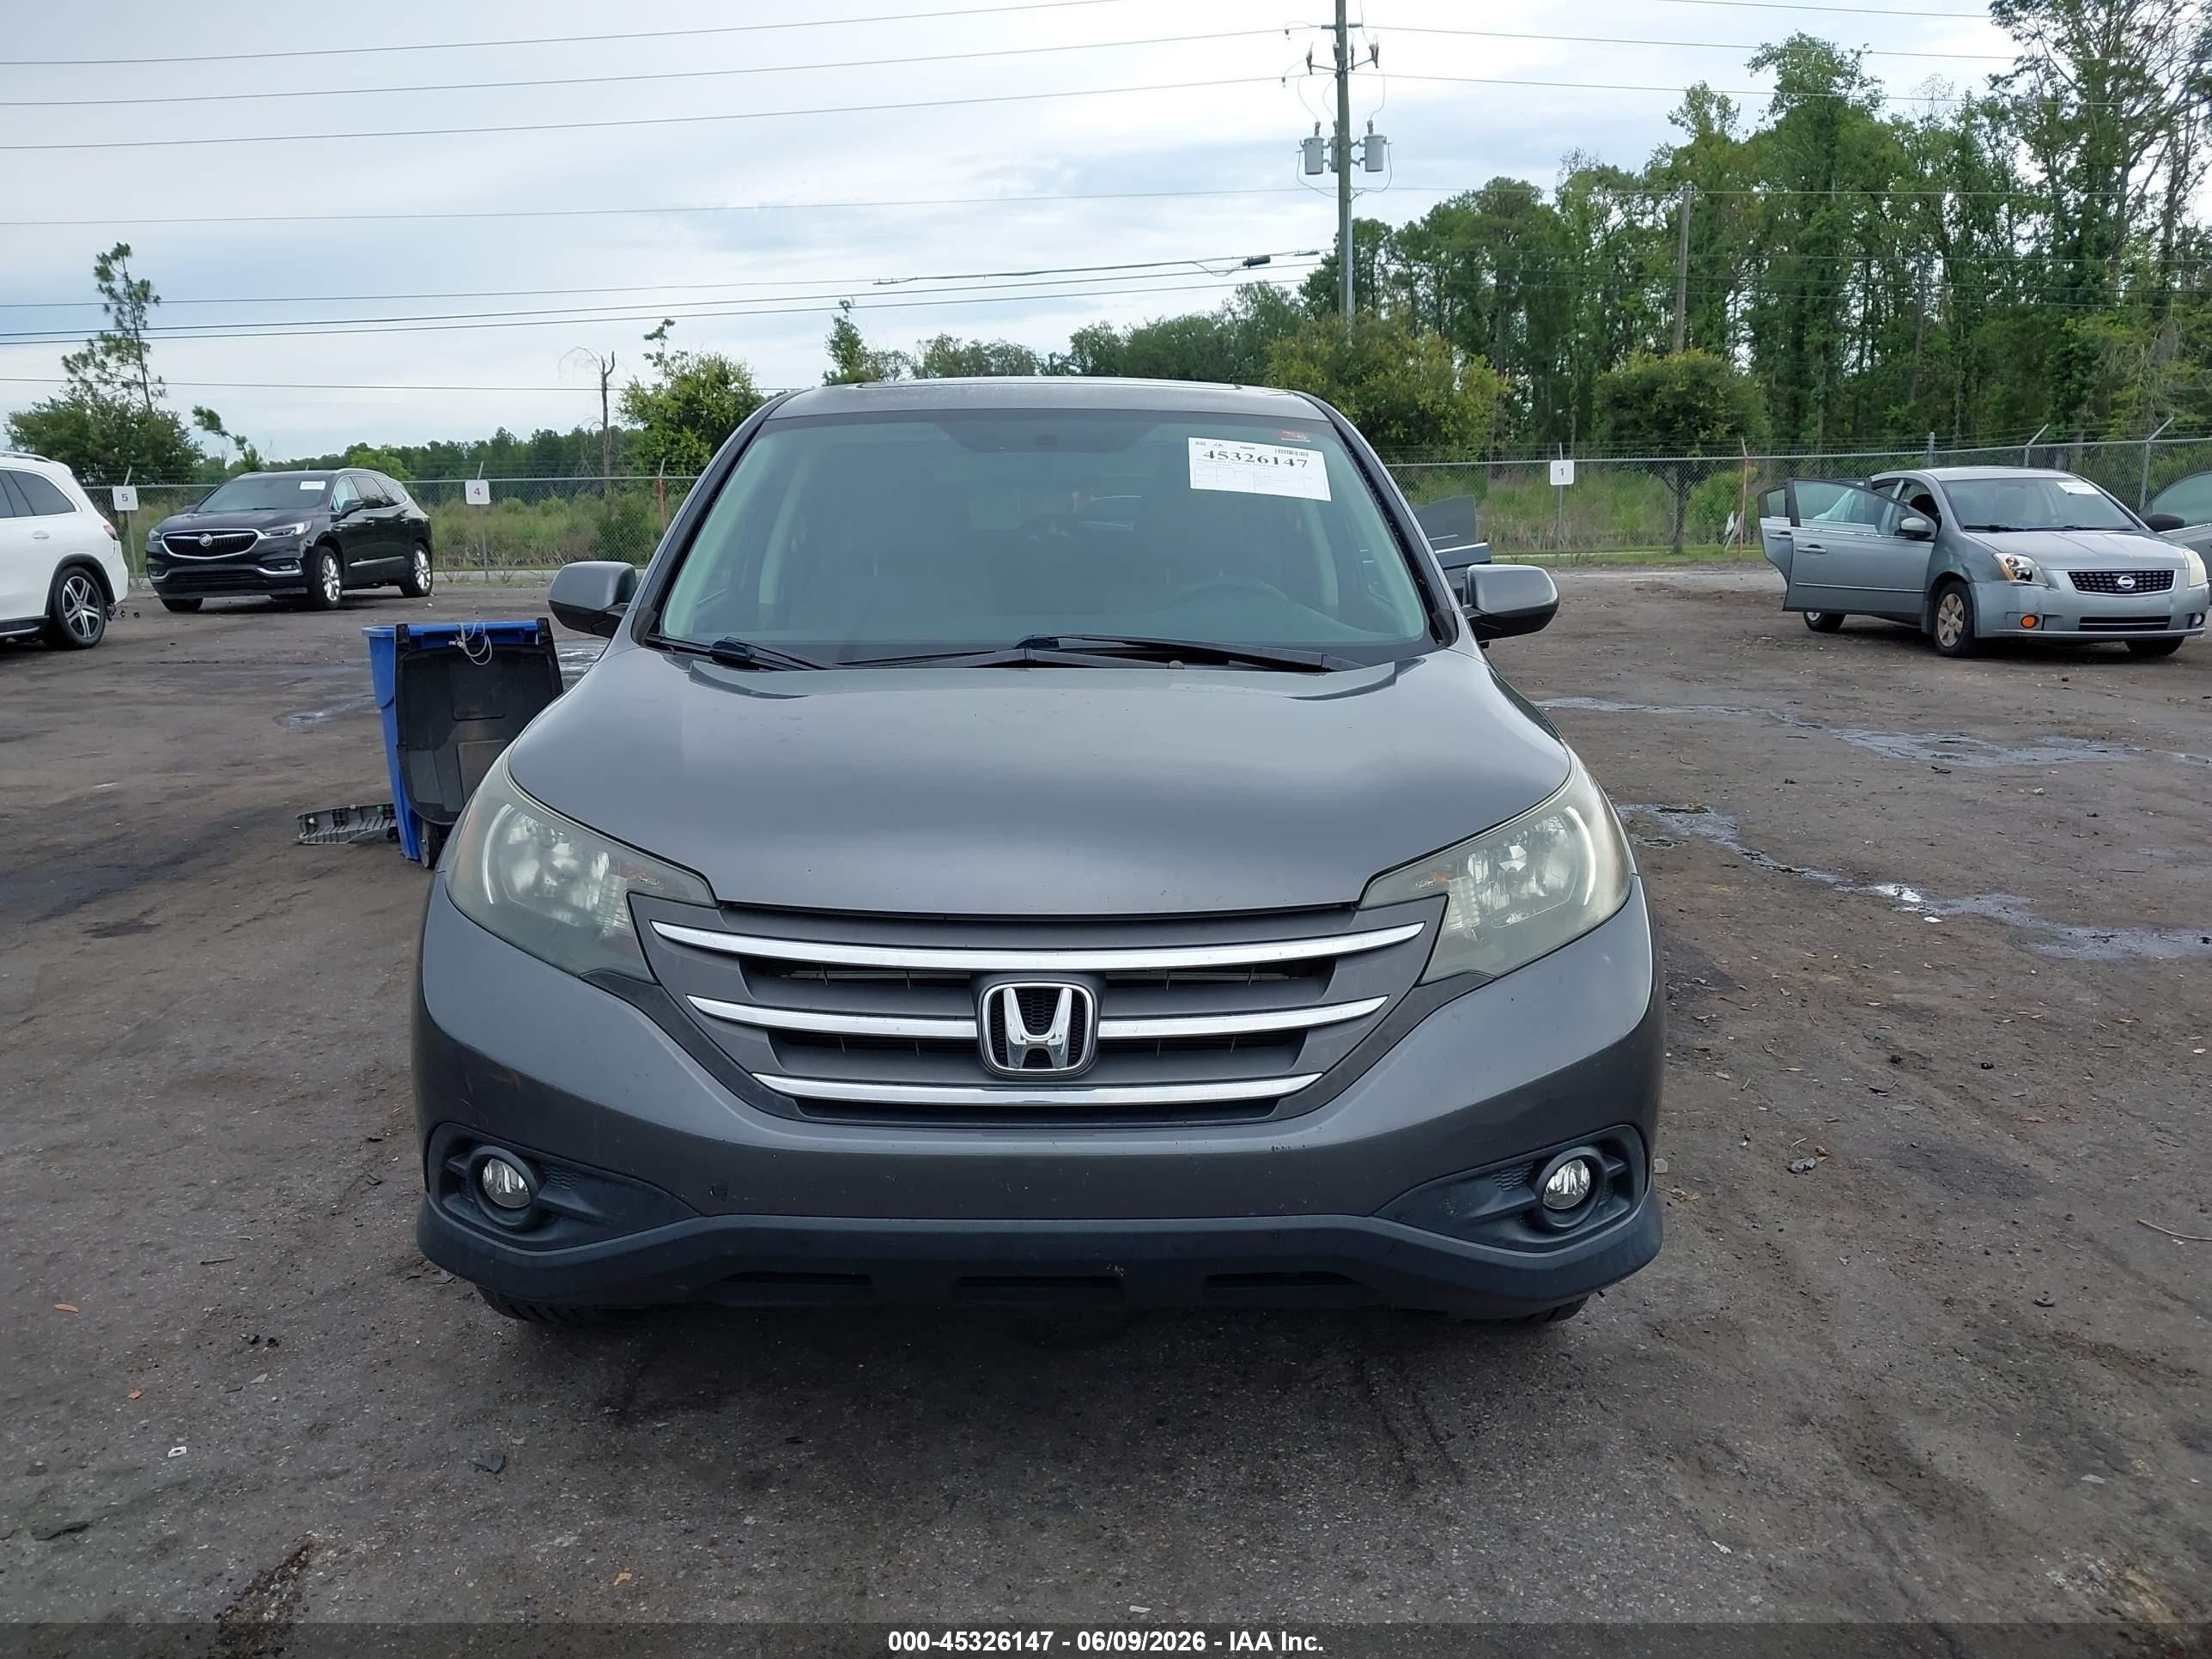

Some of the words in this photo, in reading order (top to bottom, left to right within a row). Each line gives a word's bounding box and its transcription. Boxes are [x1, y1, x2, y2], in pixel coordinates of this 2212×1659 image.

[1203, 450, 1309, 468] 45326147
[1559, 467, 1565, 476] 1
[473, 487, 481, 495] 4
[121, 493, 129, 502] 5
